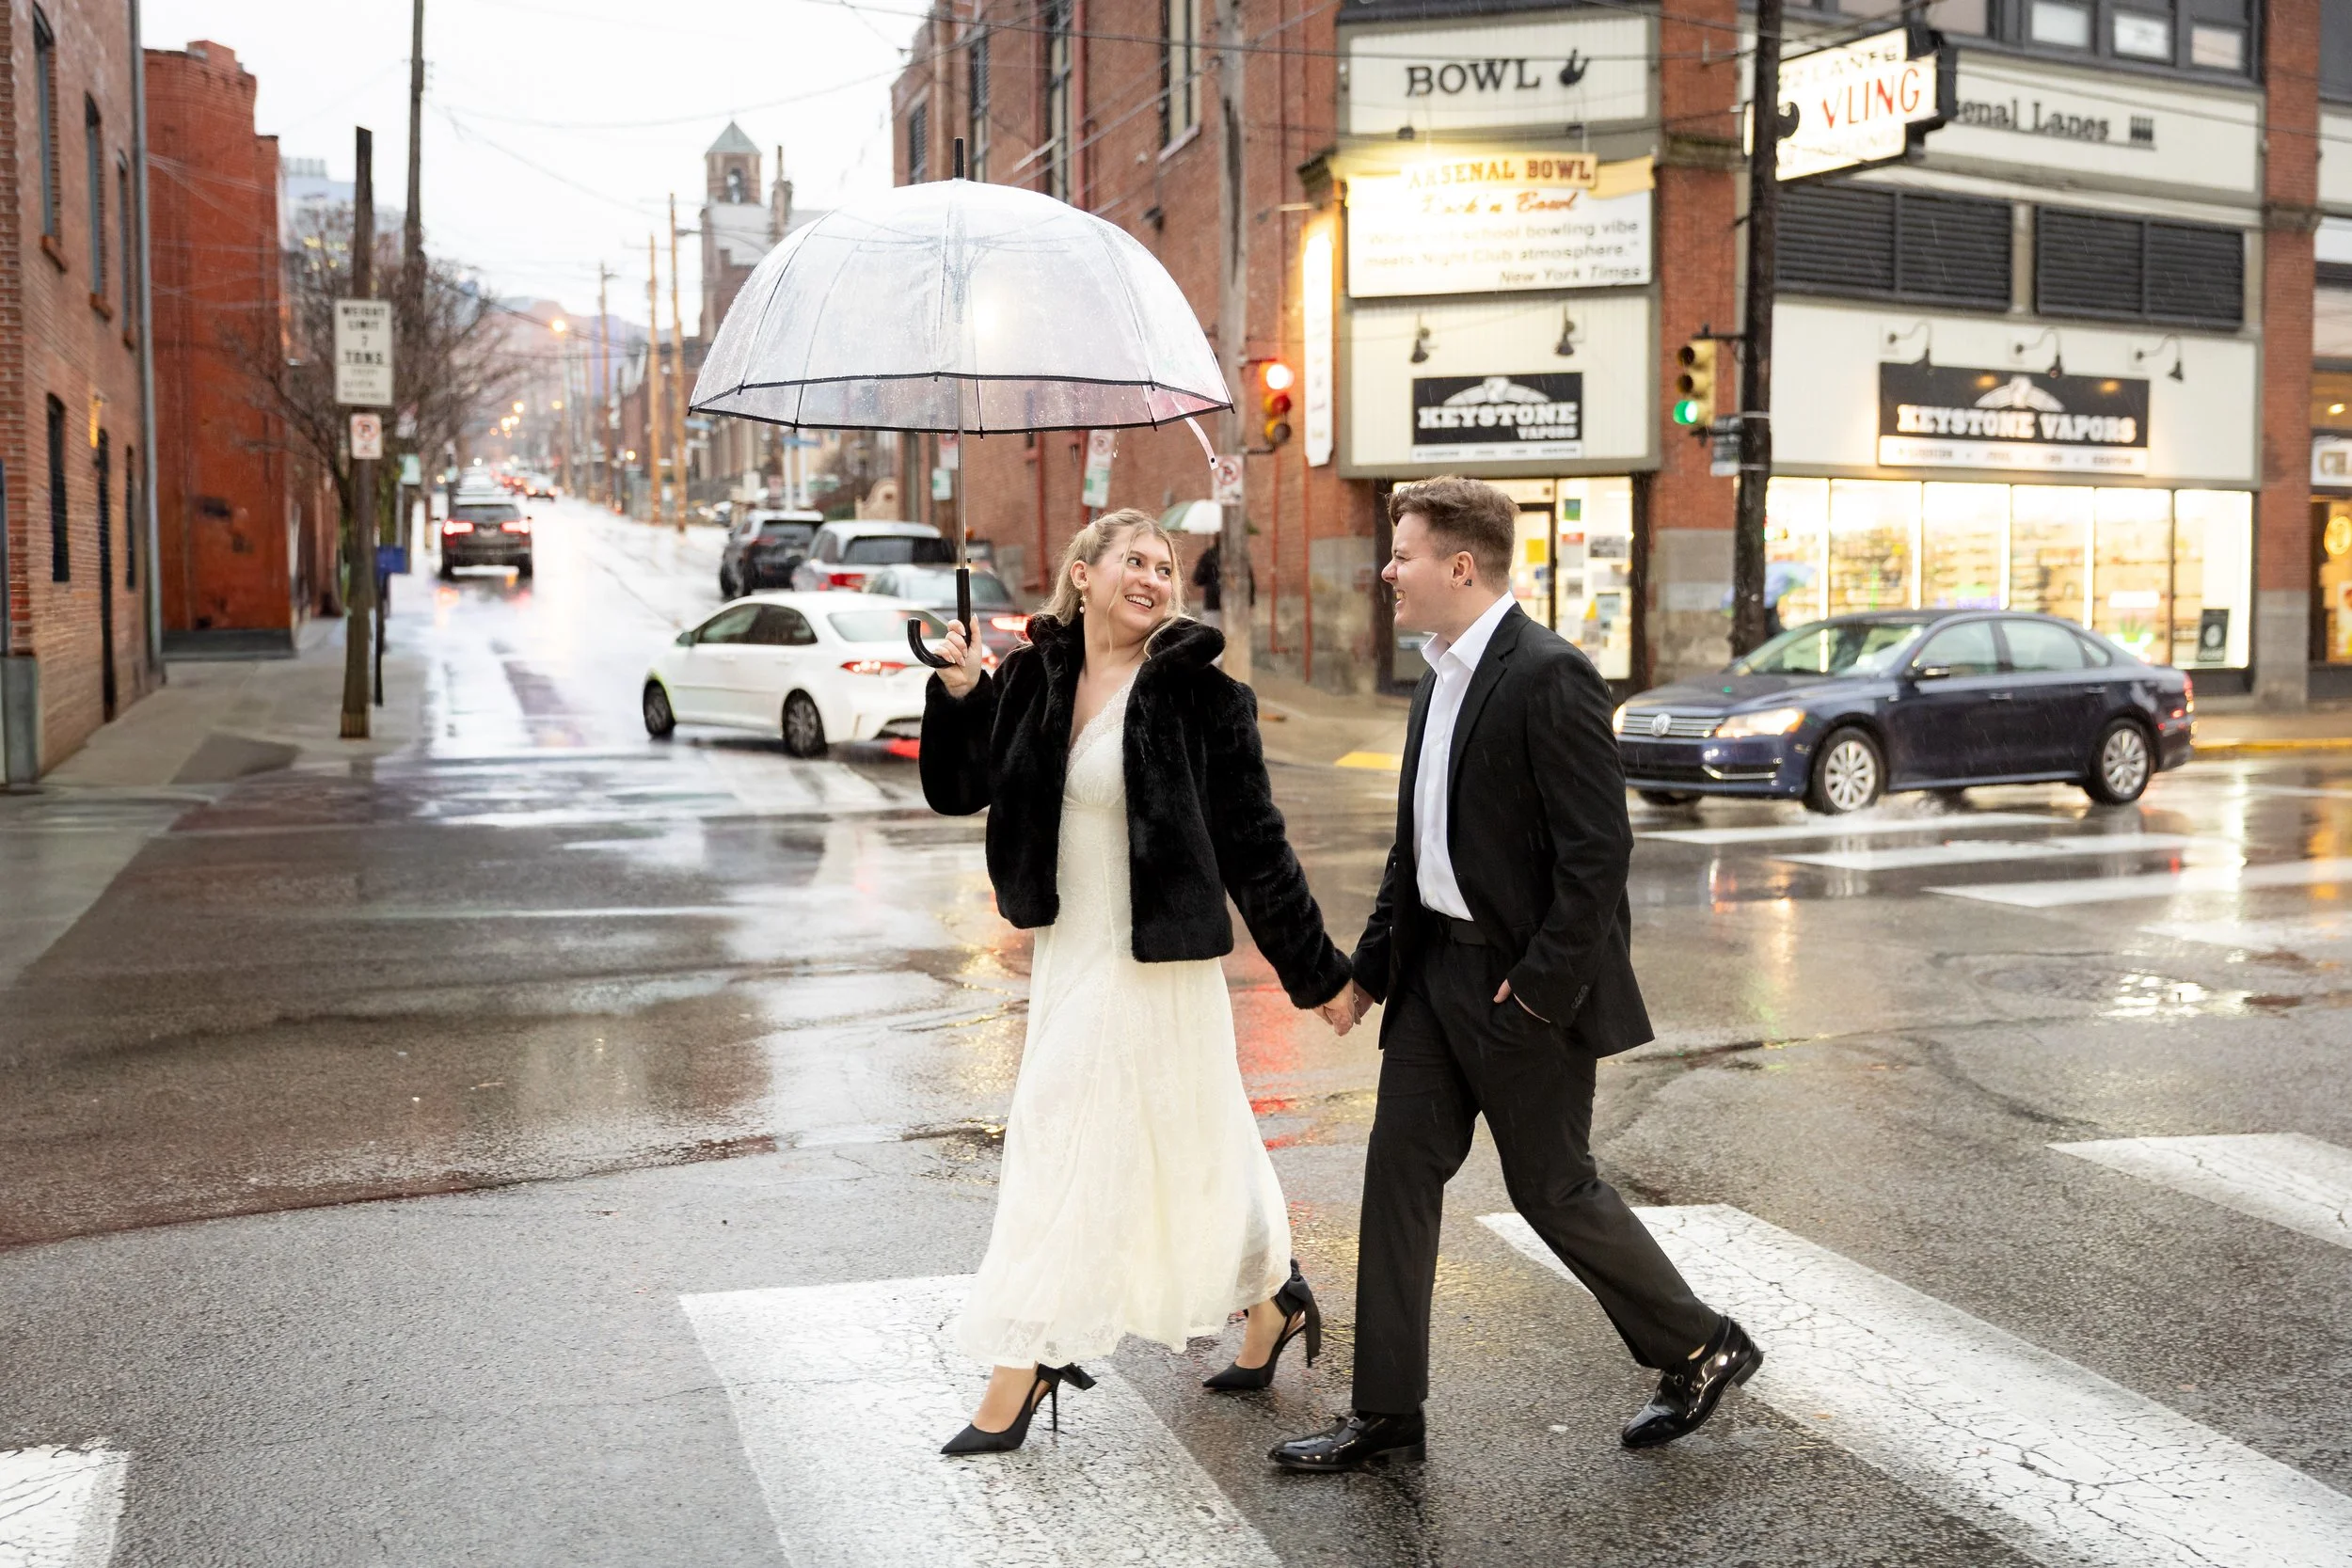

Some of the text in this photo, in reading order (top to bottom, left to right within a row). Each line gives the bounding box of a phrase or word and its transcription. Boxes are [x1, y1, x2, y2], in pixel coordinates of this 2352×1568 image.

[1405, 58, 1541, 97] BOWL
[2033, 103, 2109, 141] Lanes
[1409, 158, 1593, 189] ARSENAL BOWL
[1516, 190, 1580, 214] Bowl
[1525, 218, 1596, 238] bowling
[1601, 216, 1640, 234] vibe
[1471, 246, 1515, 264] Club
[1498, 263, 1643, 286] New York Times
[343, 349, 385, 366] TONS
[1418, 402, 1579, 430] KEYSTONE
[1896, 404, 2137, 444] KEYSTONE VAPORS
[1516, 424, 1579, 440] VAPORS
